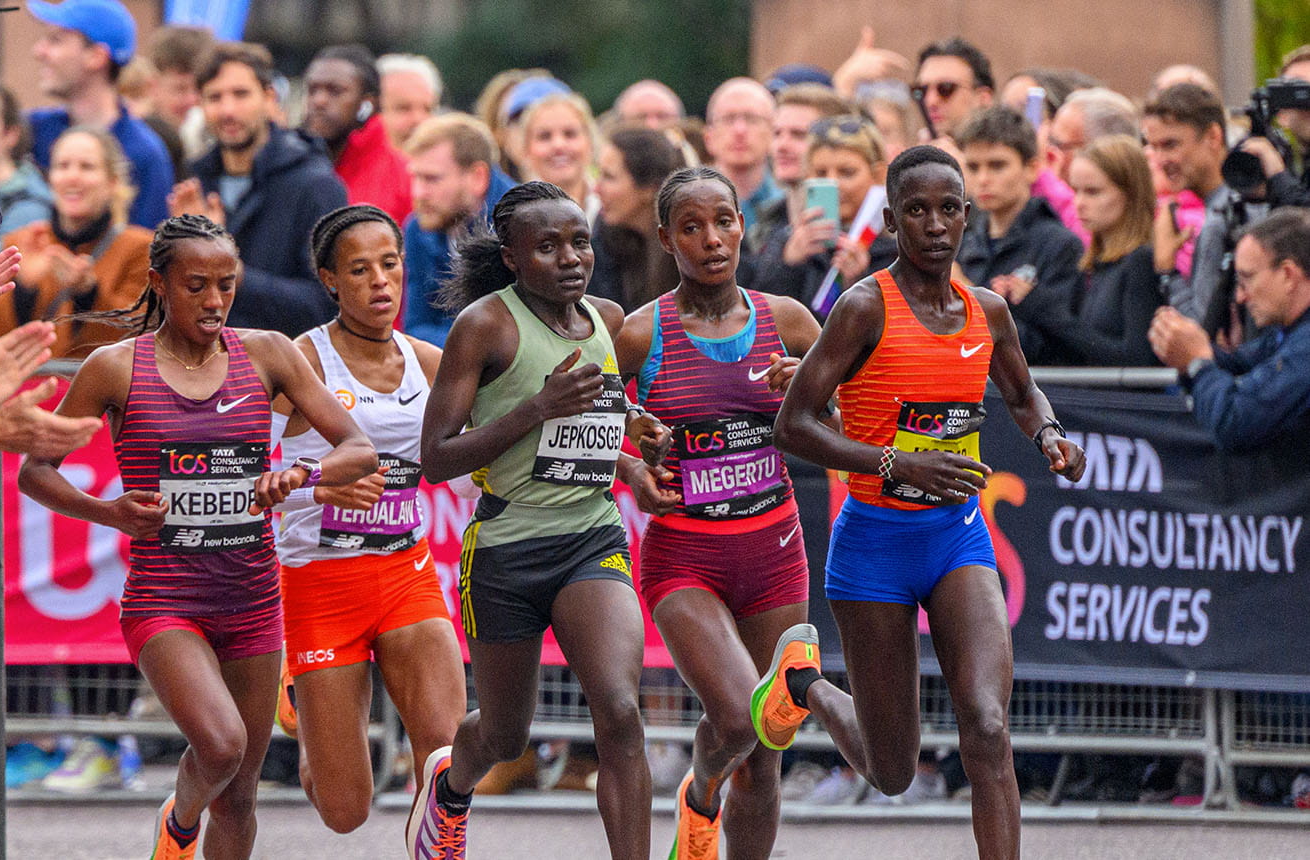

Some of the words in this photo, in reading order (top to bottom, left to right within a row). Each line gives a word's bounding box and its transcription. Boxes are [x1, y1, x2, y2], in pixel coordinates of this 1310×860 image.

[359, 396, 374, 404] NN
[947, 409, 970, 418] TATA
[726, 421, 750, 431] TATA
[906, 408, 944, 433] tcs
[685, 430, 725, 453] tcs
[728, 436, 763, 449] SERVICES
[210, 448, 235, 457] TATA
[169, 450, 208, 474] tcs
[210, 456, 259, 466] CONSULTANCY
[379, 459, 401, 467] TATA
[210, 465, 244, 474] SERVICES
[690, 454, 776, 495] MEGERTU
[573, 473, 591, 481] new
[591, 471, 611, 482] bala
[204, 538, 222, 547] new
[223, 534, 256, 546] balance
[1049, 505, 1303, 574] CONSULTANCY
[1044, 581, 1212, 647] SERVICES
[297, 648, 335, 664] INEOS
